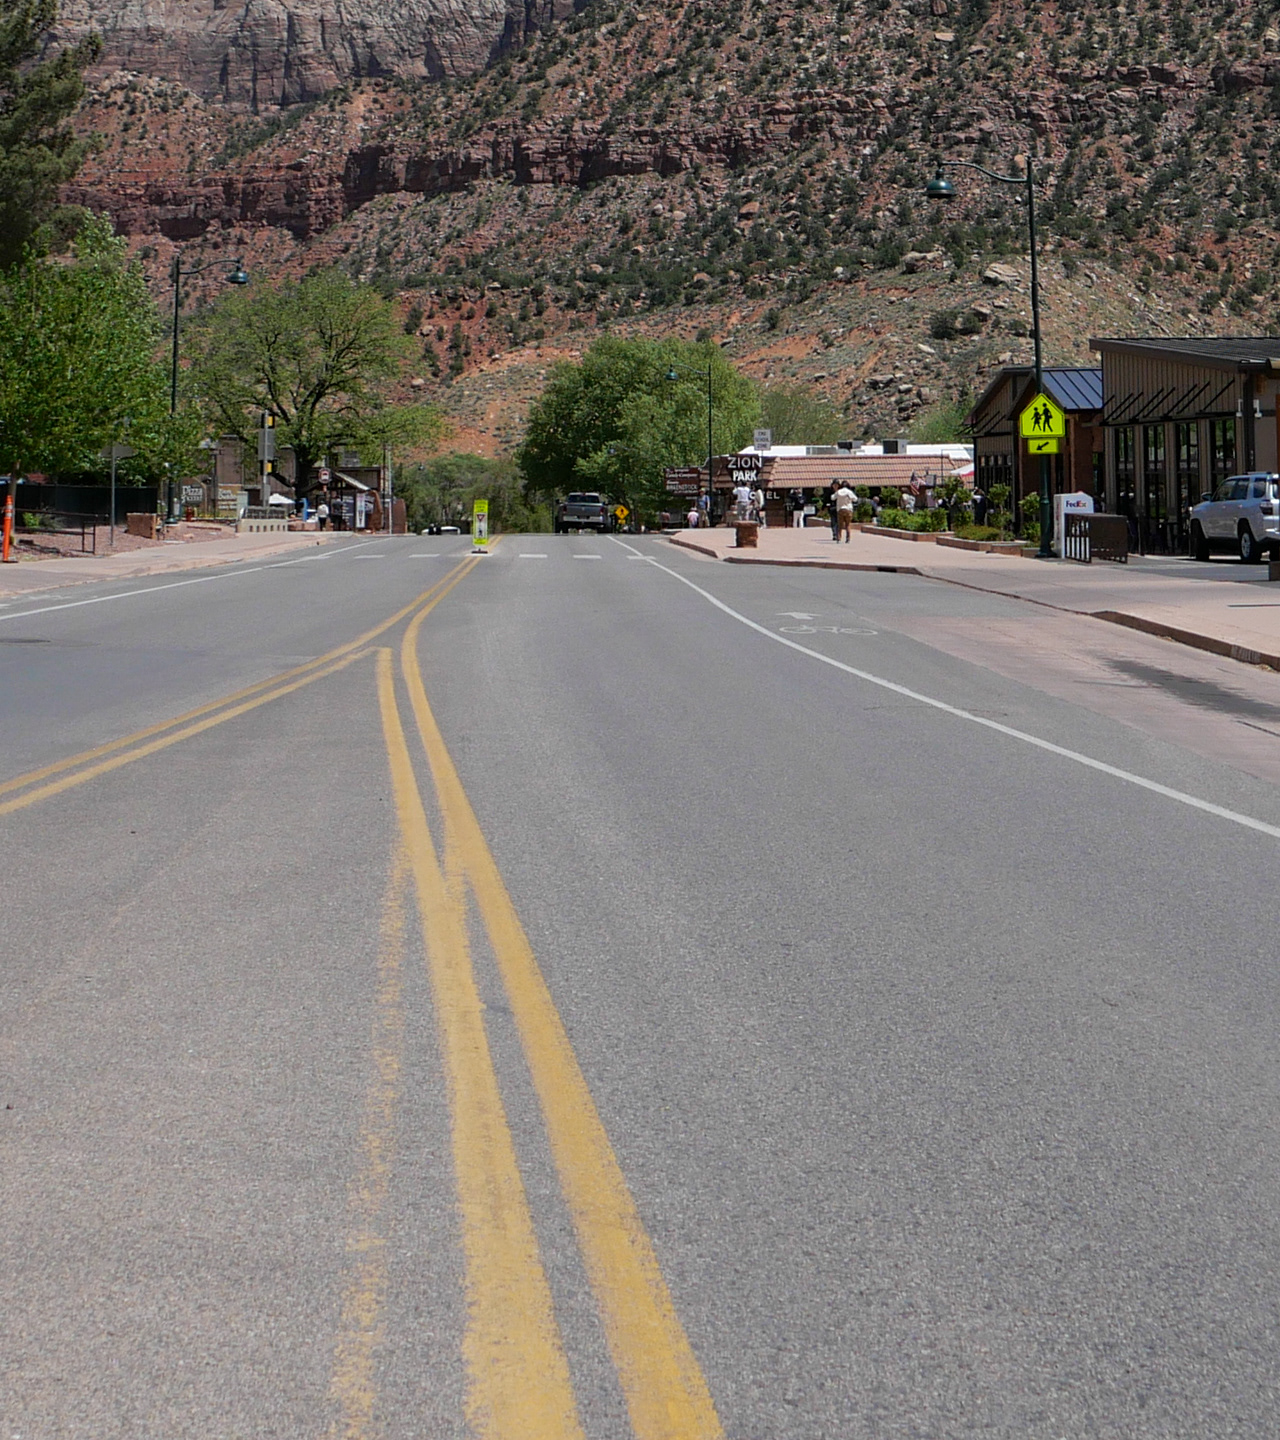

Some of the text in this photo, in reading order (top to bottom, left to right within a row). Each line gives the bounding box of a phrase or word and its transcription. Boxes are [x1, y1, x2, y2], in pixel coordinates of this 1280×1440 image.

[727, 456, 762, 469] ZION
[732, 469, 757, 482] PARK
[1065, 500, 1087, 508] FedEx
